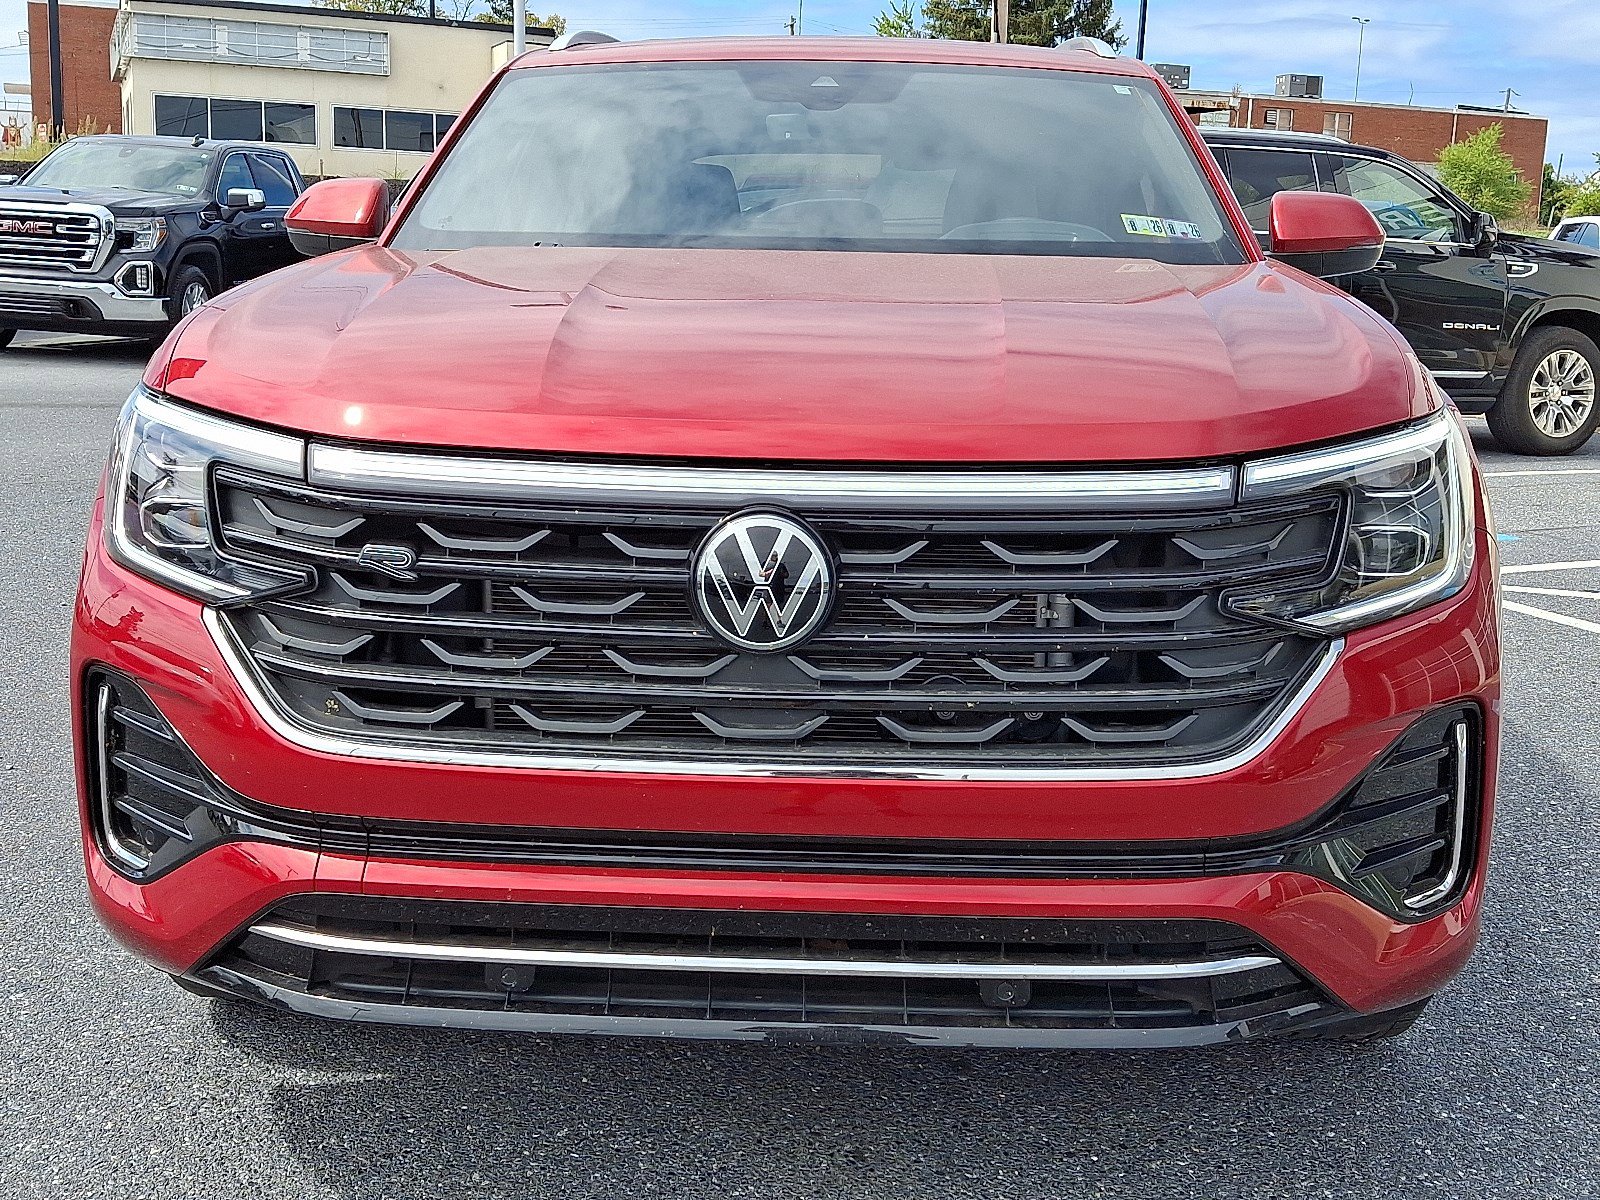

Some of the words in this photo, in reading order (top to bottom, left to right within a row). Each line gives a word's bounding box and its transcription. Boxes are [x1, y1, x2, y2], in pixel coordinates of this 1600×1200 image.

[0, 219, 53, 234] GMC
[1150, 219, 1163, 233] 26
[1442, 322, 1500, 331] DENALI
[356, 544, 418, 582] R
